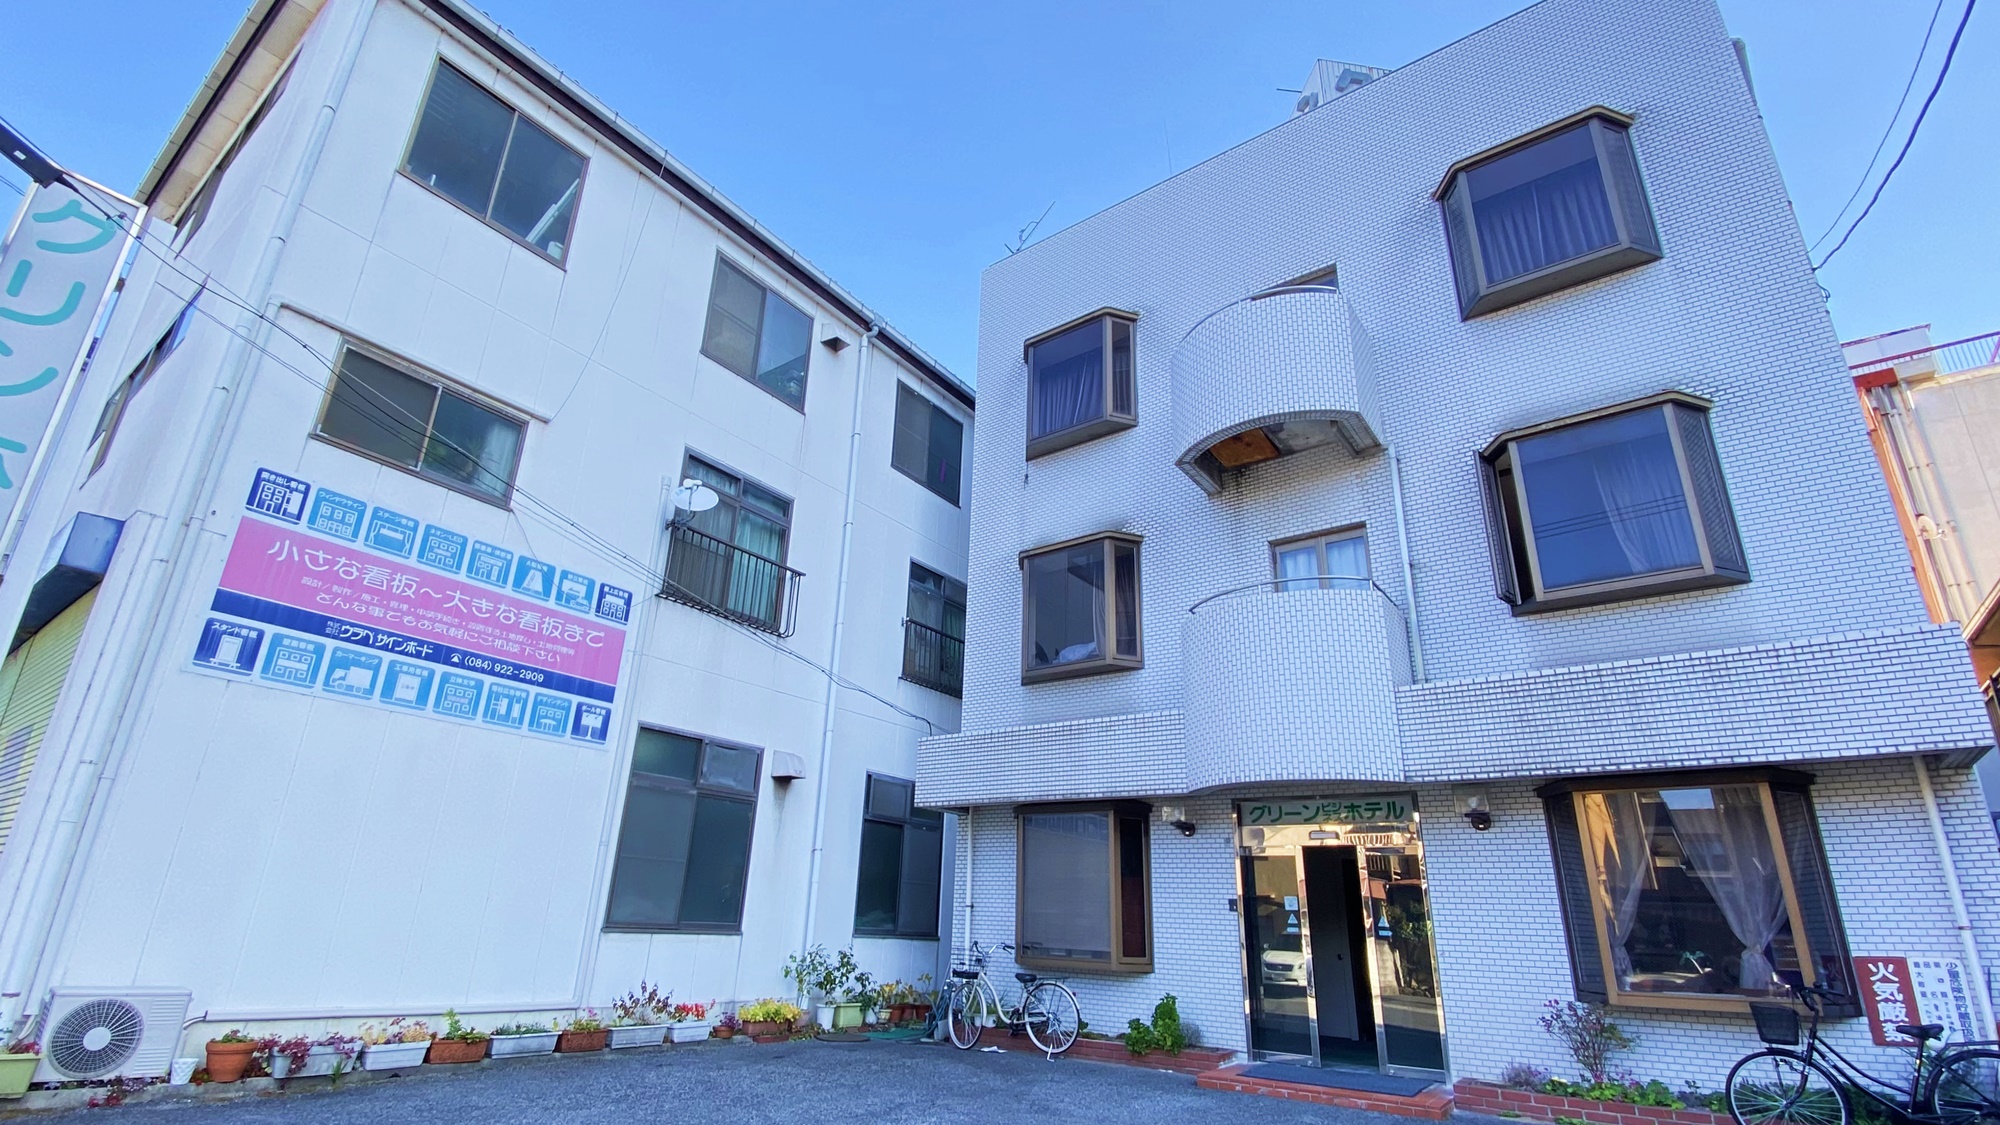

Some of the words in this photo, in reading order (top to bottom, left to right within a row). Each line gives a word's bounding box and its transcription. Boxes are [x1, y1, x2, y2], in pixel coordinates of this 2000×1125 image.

[211, 621, 258, 639] スタンド看板
[1867, 961, 1914, 1042] 火気厳禁
